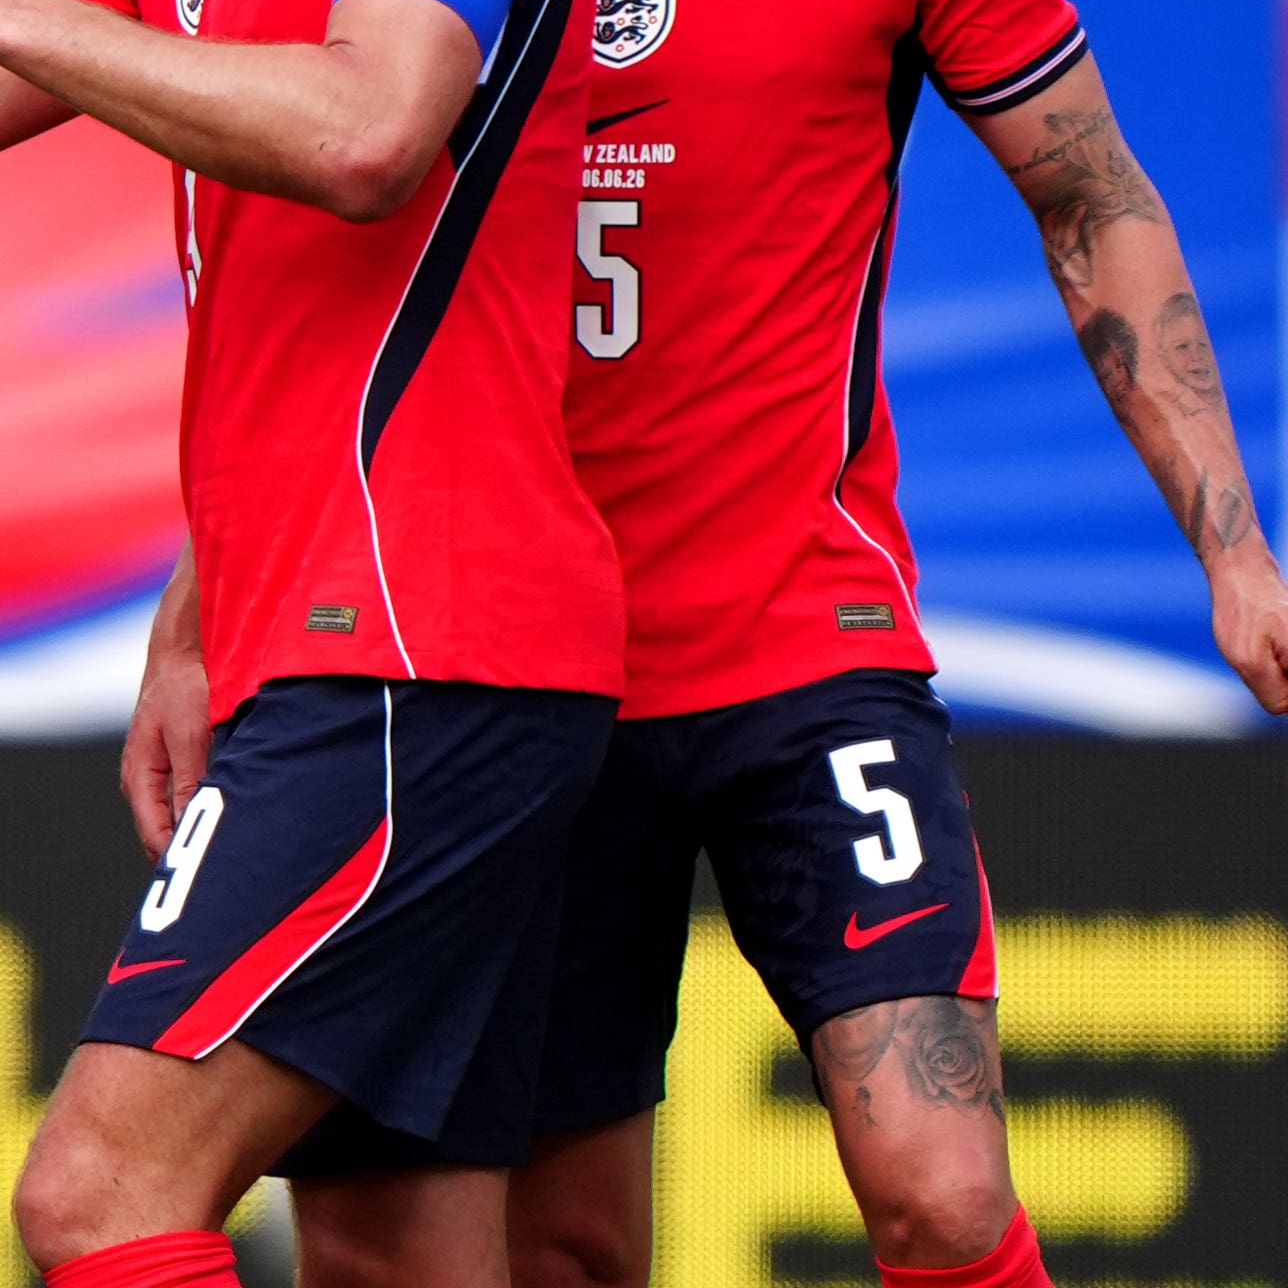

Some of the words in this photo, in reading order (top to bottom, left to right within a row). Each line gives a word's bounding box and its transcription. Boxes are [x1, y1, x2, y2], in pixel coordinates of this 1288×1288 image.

[582, 168, 646, 189] 06.06.26
[596, 143, 676, 164] ZEALAND
[576, 199, 641, 360] 5
[139, 785, 226, 933] 9
[827, 738, 925, 886] 5
